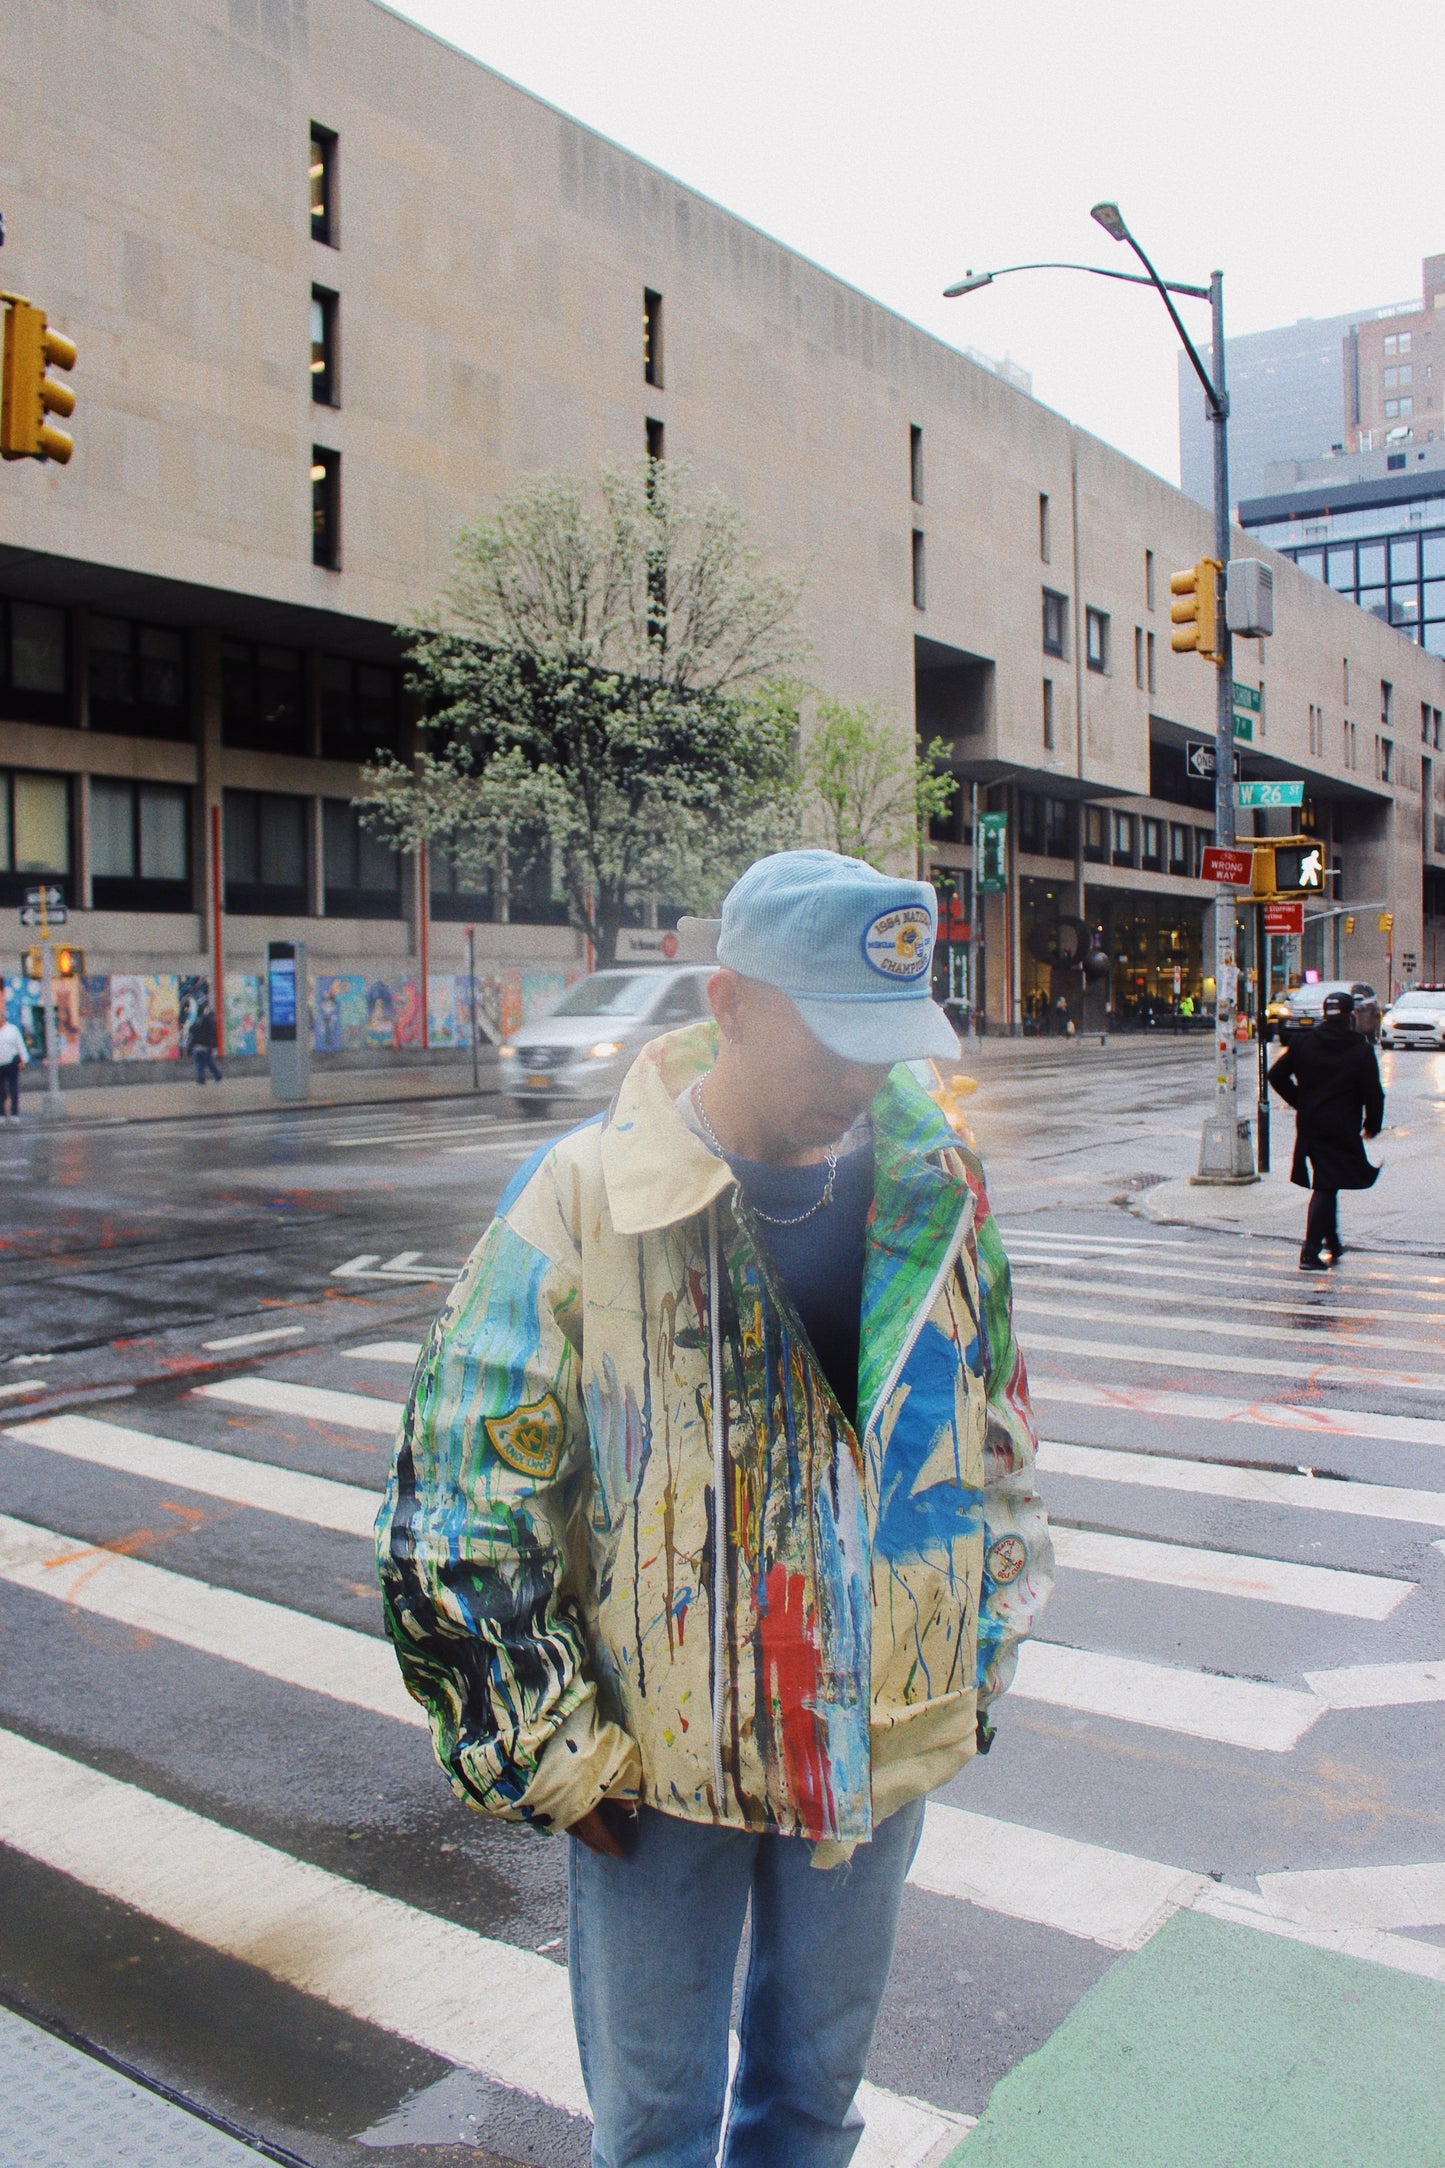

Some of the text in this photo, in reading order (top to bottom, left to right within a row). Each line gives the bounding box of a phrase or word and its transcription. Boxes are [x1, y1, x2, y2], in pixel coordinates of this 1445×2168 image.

[1196, 754, 1214, 769] ONE
[1241, 785, 1300, 804] W 26 ST
[1211, 860, 1243, 872] WRONG
[1216, 871, 1236, 880] WAY
[875, 914, 901, 935] 1984
[521, 1429, 541, 1449] K
[994, 1540, 1015, 1555] SEATTLE
[997, 1559, 1023, 1580] GOLF CLUB
